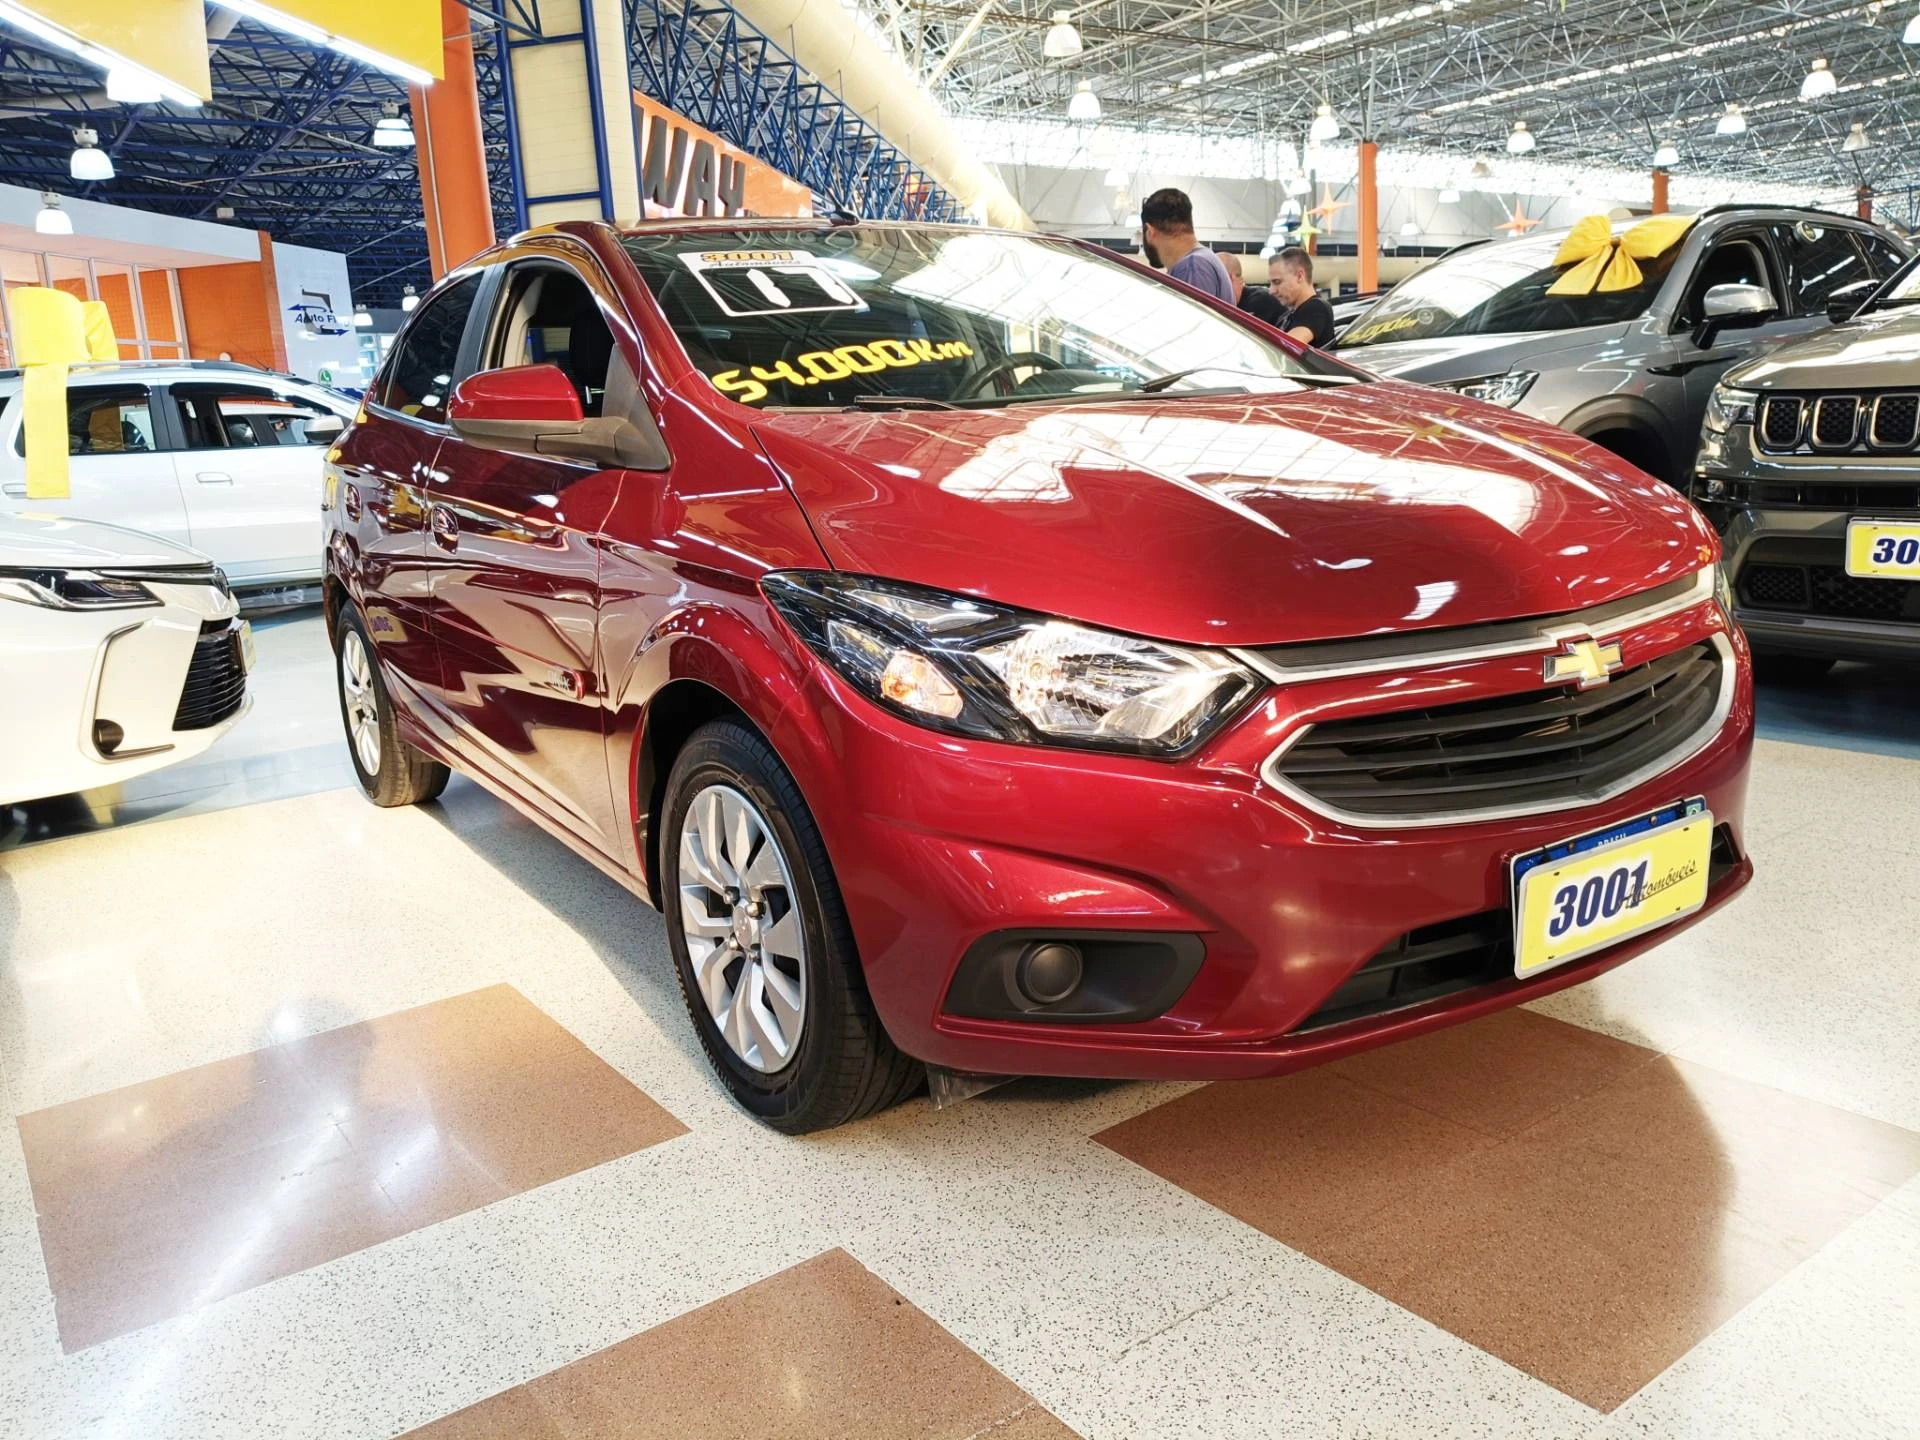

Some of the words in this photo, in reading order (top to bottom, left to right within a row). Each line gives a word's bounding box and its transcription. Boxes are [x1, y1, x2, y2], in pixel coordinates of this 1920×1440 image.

[701, 251, 794, 263] 3001
[746, 266, 854, 308] 17
[711, 338, 974, 403] 54.000Km
[1873, 538, 1920, 565] 30
[1549, 859, 1648, 938] 3001
